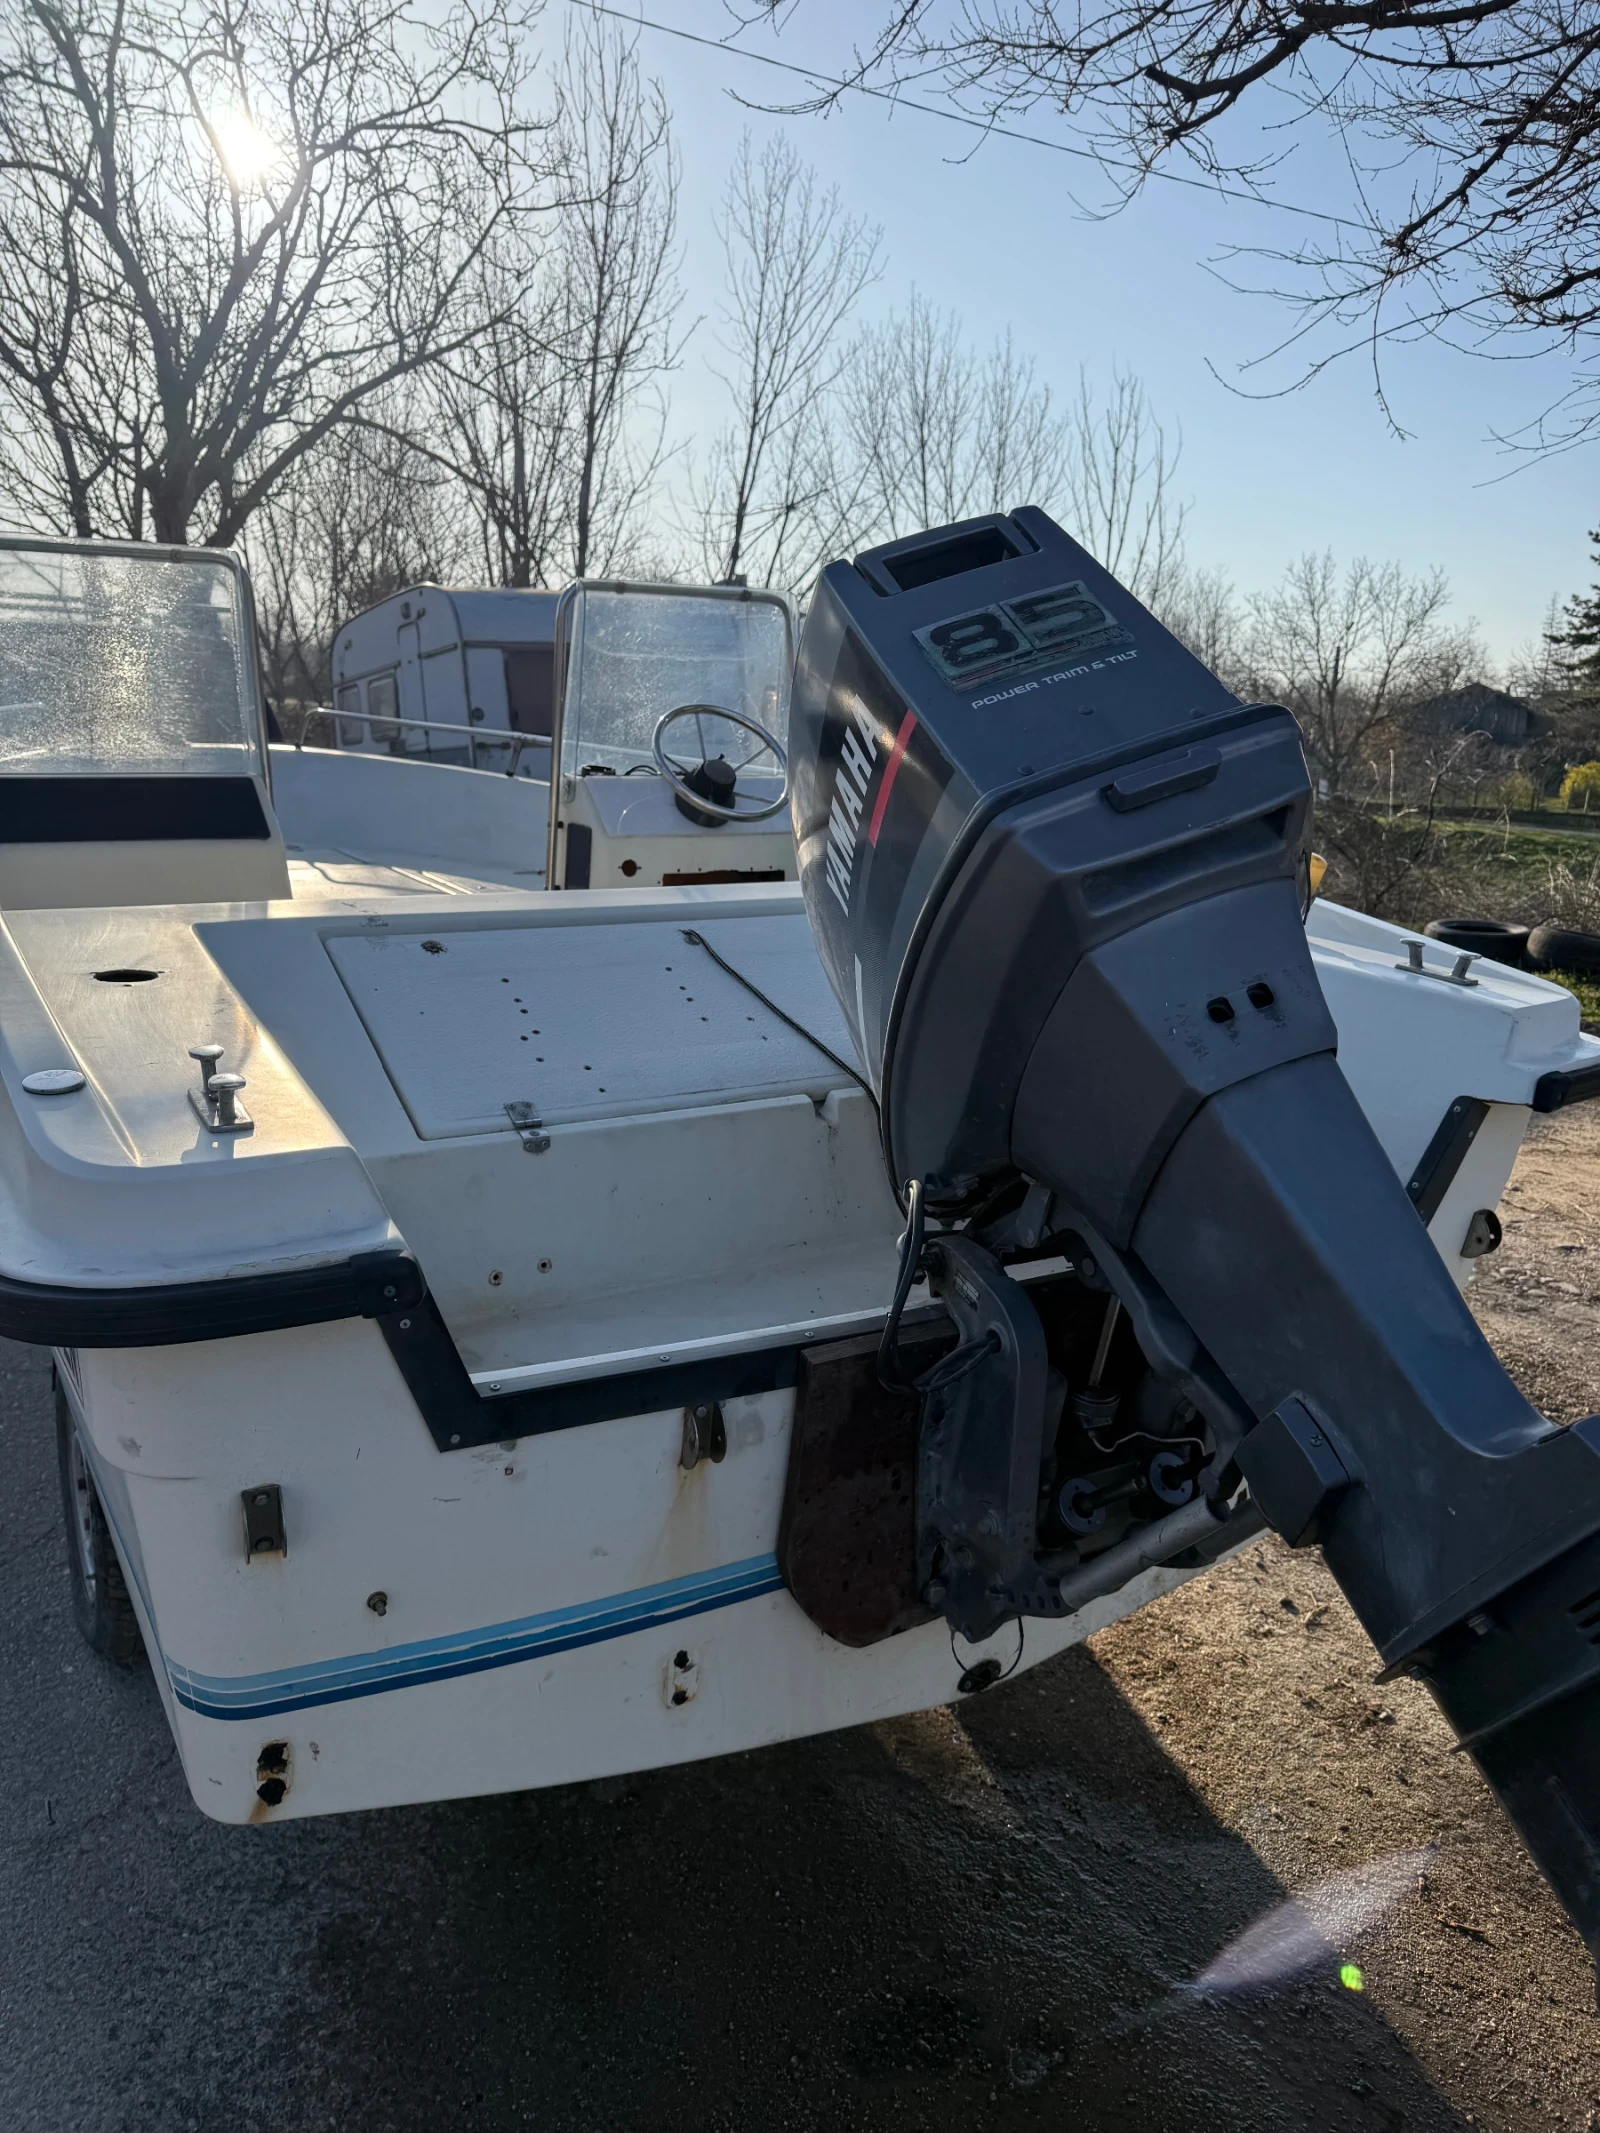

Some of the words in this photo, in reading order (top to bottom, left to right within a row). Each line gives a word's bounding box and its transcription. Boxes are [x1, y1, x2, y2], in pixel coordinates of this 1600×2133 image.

[930, 584, 1106, 668] 85
[971, 681, 1040, 710] POWER
[1041, 666, 1090, 684] TRIM
[1092, 660, 1105, 670] &
[1105, 649, 1138, 665] TILT
[826, 693, 883, 918] YAMAHA
